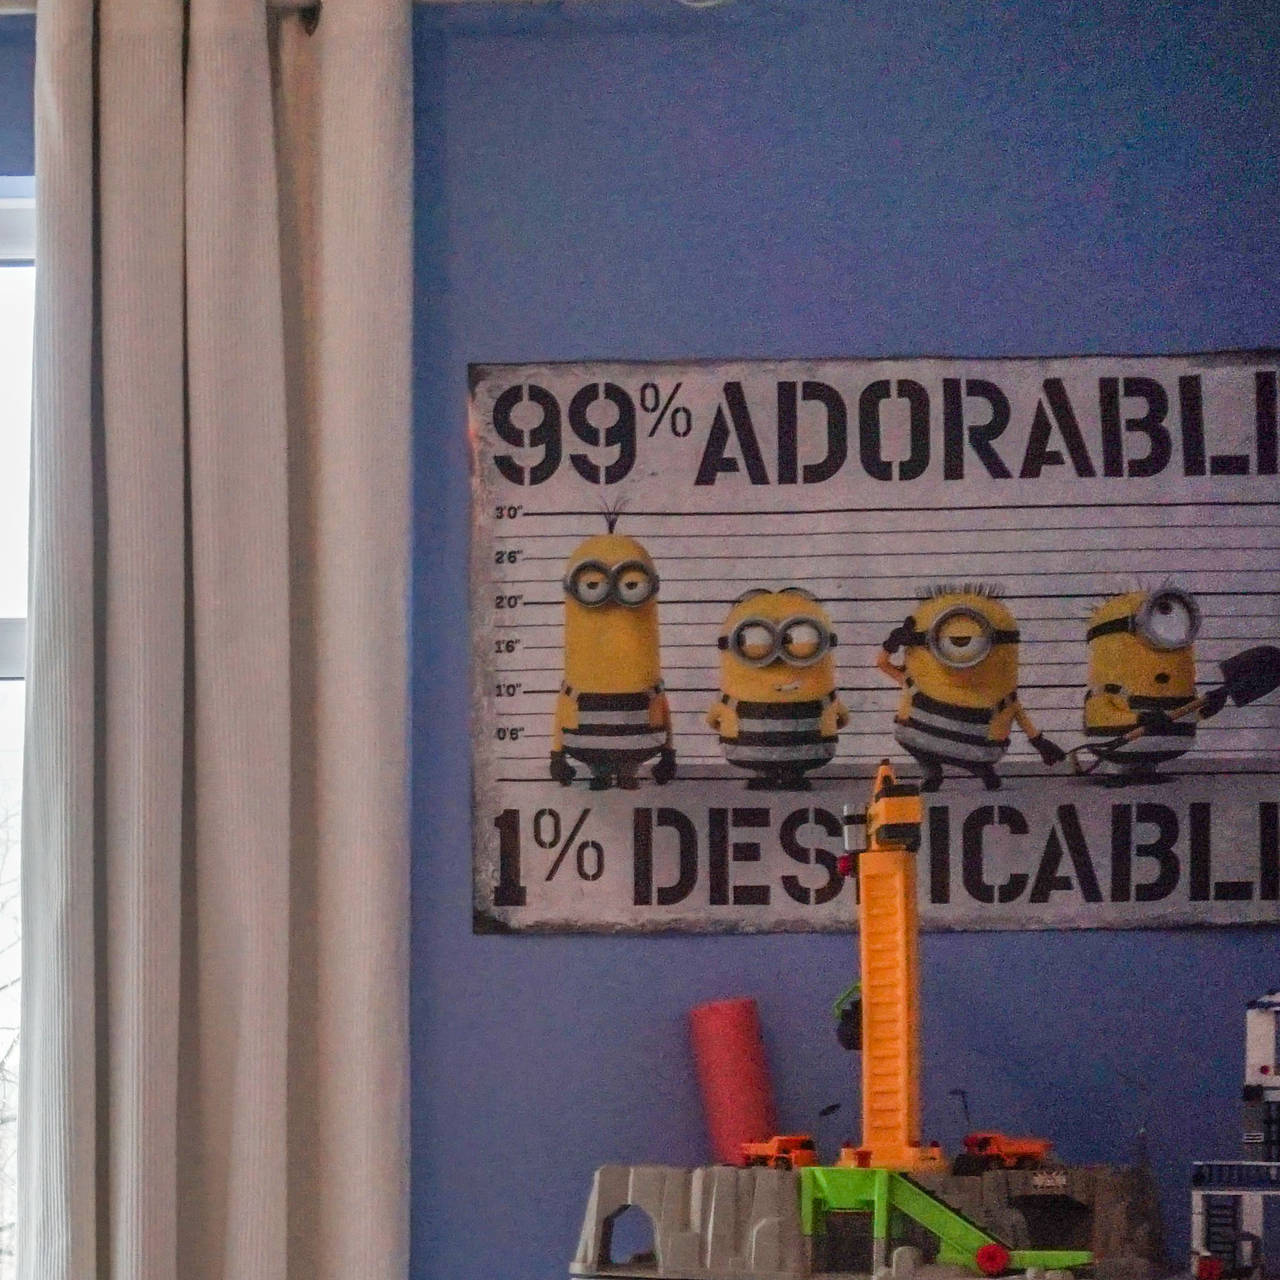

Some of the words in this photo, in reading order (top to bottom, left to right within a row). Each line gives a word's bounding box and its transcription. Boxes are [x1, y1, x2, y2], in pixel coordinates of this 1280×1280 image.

[490, 380, 694, 487] 99%
[492, 806, 605, 908] 1%
[633, 801, 1279, 906] DESICABL
